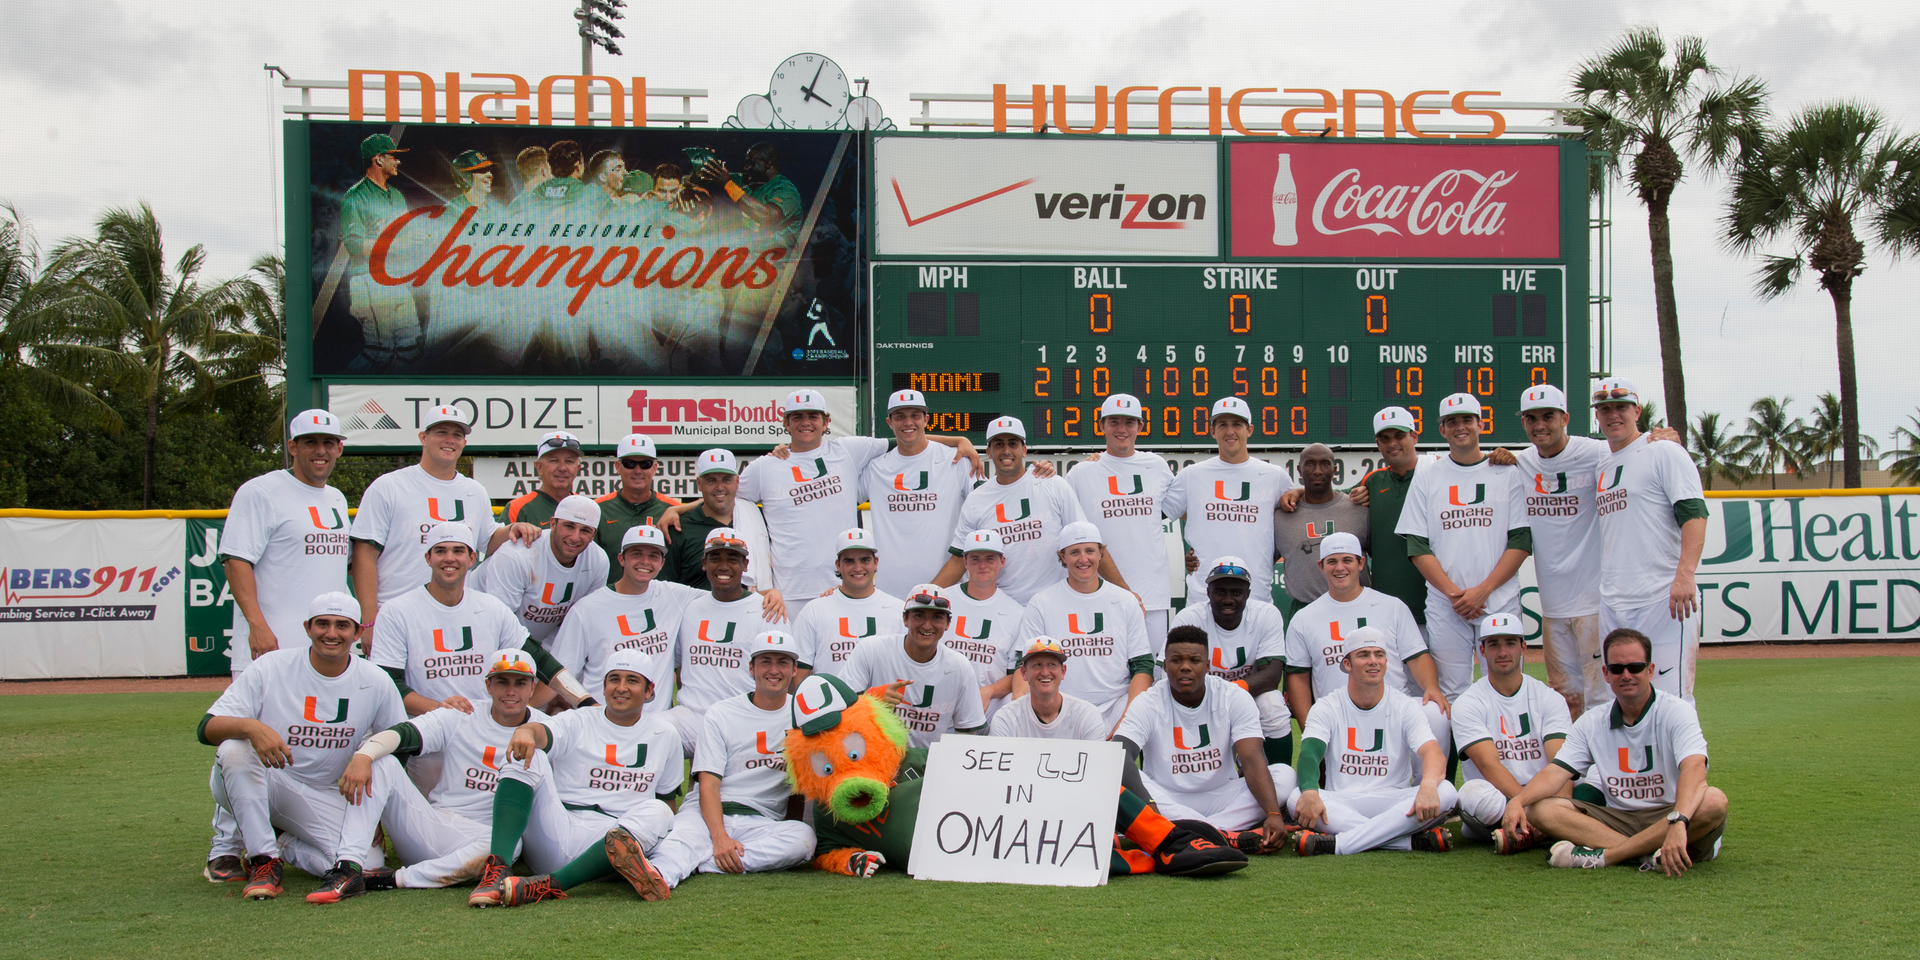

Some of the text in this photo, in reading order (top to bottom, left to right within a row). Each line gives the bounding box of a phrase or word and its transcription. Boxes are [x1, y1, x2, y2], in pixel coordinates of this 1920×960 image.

[1035, 184, 1207, 229] verizon
[1312, 168, 1520, 237] Coca-Cola
[468, 222, 654, 239] SUPER REGIONAL
[368, 204, 787, 316] Champions
[919, 267, 968, 289] MPH
[1074, 267, 1127, 289] BALL
[1203, 268, 1278, 290] STRIKE
[1356, 269, 1398, 291] OUT
[1502, 269, 1537, 292] H/E
[1090, 294, 1111, 333] 0
[1230, 294, 1251, 333] 0
[1366, 295, 1388, 333] 0
[1037, 345, 1556, 364] 1 2 3 4 5 6 7 8 9 10 RUNS HITS ERR
[910, 372, 983, 392] MIAMI
[1034, 367, 1050, 396] 2
[1093, 367, 1110, 396] 0
[1163, 367, 1179, 396] 0
[1192, 367, 1209, 396] 0
[1232, 367, 1249, 396] 5
[1261, 367, 1278, 396] 0
[1396, 367, 1423, 396] 10
[1466, 367, 1494, 396] 10
[1064, 407, 1081, 436] 2
[1163, 406, 1180, 436] 0
[1193, 406, 1209, 436] 0
[1262, 406, 1278, 436] 0
[1291, 406, 1307, 436] 0
[674, 425, 731, 438] Municipal
[735, 425, 764, 435] Bond
[789, 475, 841, 498] OMAHA
[794, 484, 843, 506] BOUND
[887, 493, 938, 503] OMAHA
[1101, 496, 1153, 509] OMAHA
[1526, 495, 1579, 506] OMAHA
[1596, 488, 1628, 507] MAHA
[889, 502, 936, 512] BOUND
[1103, 506, 1152, 519] BOUND
[1205, 502, 1259, 514] OMAHA
[1440, 507, 1494, 520] OMAHA
[1527, 506, 1578, 516] BOUND
[1598, 499, 1628, 517] OUND
[1206, 512, 1257, 523] BOUND
[1443, 517, 1492, 530] BOUND
[1002, 530, 1042, 545] OUND
[35, 608, 76, 619] Service
[80, 607, 116, 618] 1-Click
[119, 609, 151, 620] Away
[523, 610, 564, 624] BOUN
[528, 604, 569, 615] OMAH
[689, 645, 743, 659] OMAHA
[424, 654, 484, 669] OMAHA
[690, 656, 741, 669] BOUND
[425, 665, 483, 680] BOUND
[892, 706, 941, 722] MAHA
[287, 725, 355, 738] OMAHA
[287, 736, 351, 749] BOUND
[962, 749, 1088, 782] SEE U
[590, 768, 655, 783] OMAHA
[1607, 773, 1665, 788] OMAHA
[1006, 783, 1033, 804] IN
[1608, 786, 1665, 799] BOUND
[937, 811, 1100, 870] OMAHA
